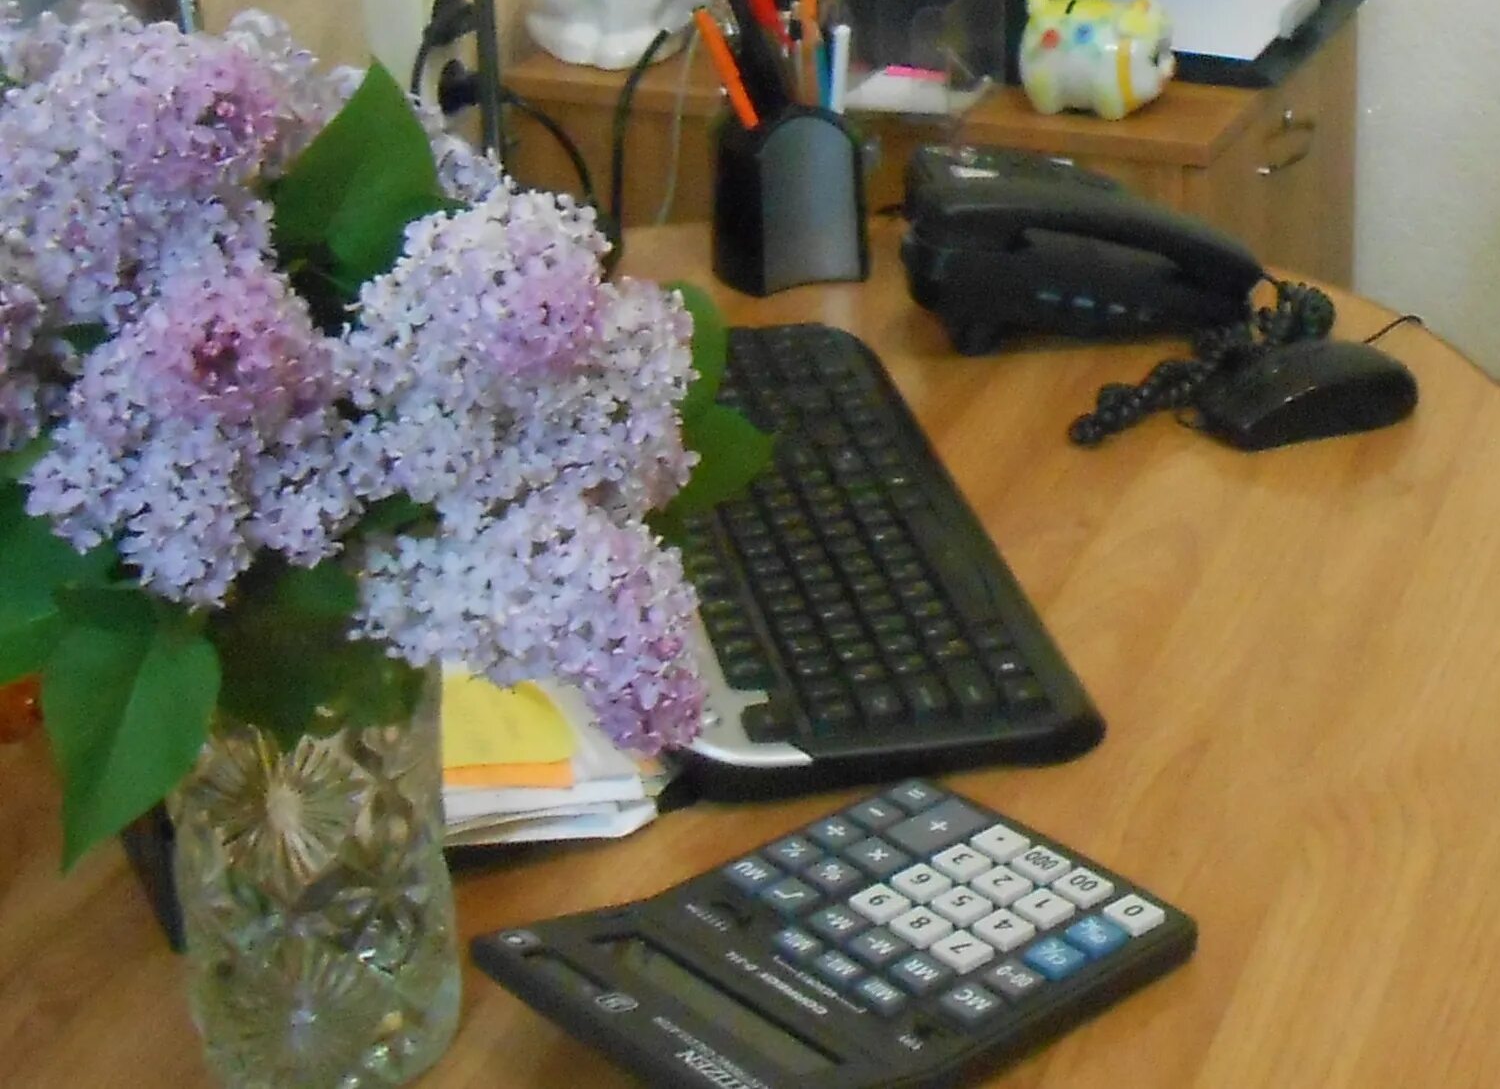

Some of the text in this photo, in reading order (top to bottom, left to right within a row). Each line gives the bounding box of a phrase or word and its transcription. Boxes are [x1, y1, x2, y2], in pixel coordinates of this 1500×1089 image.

[951, 853, 974, 865] 3
[1024, 851, 1060, 871] 000
[733, 861, 767, 881] MU
[909, 873, 932, 885] 6
[992, 874, 1014, 887] 2
[1069, 874, 1099, 892] 00
[868, 894, 891, 906] 9
[950, 894, 974, 907] 5
[1123, 904, 1145, 917] 0
[909, 916, 932, 930] 8
[993, 918, 1014, 930] 4
[948, 942, 973, 955] 7
[904, 959, 939, 981] MR
[953, 988, 992, 1011] MC
